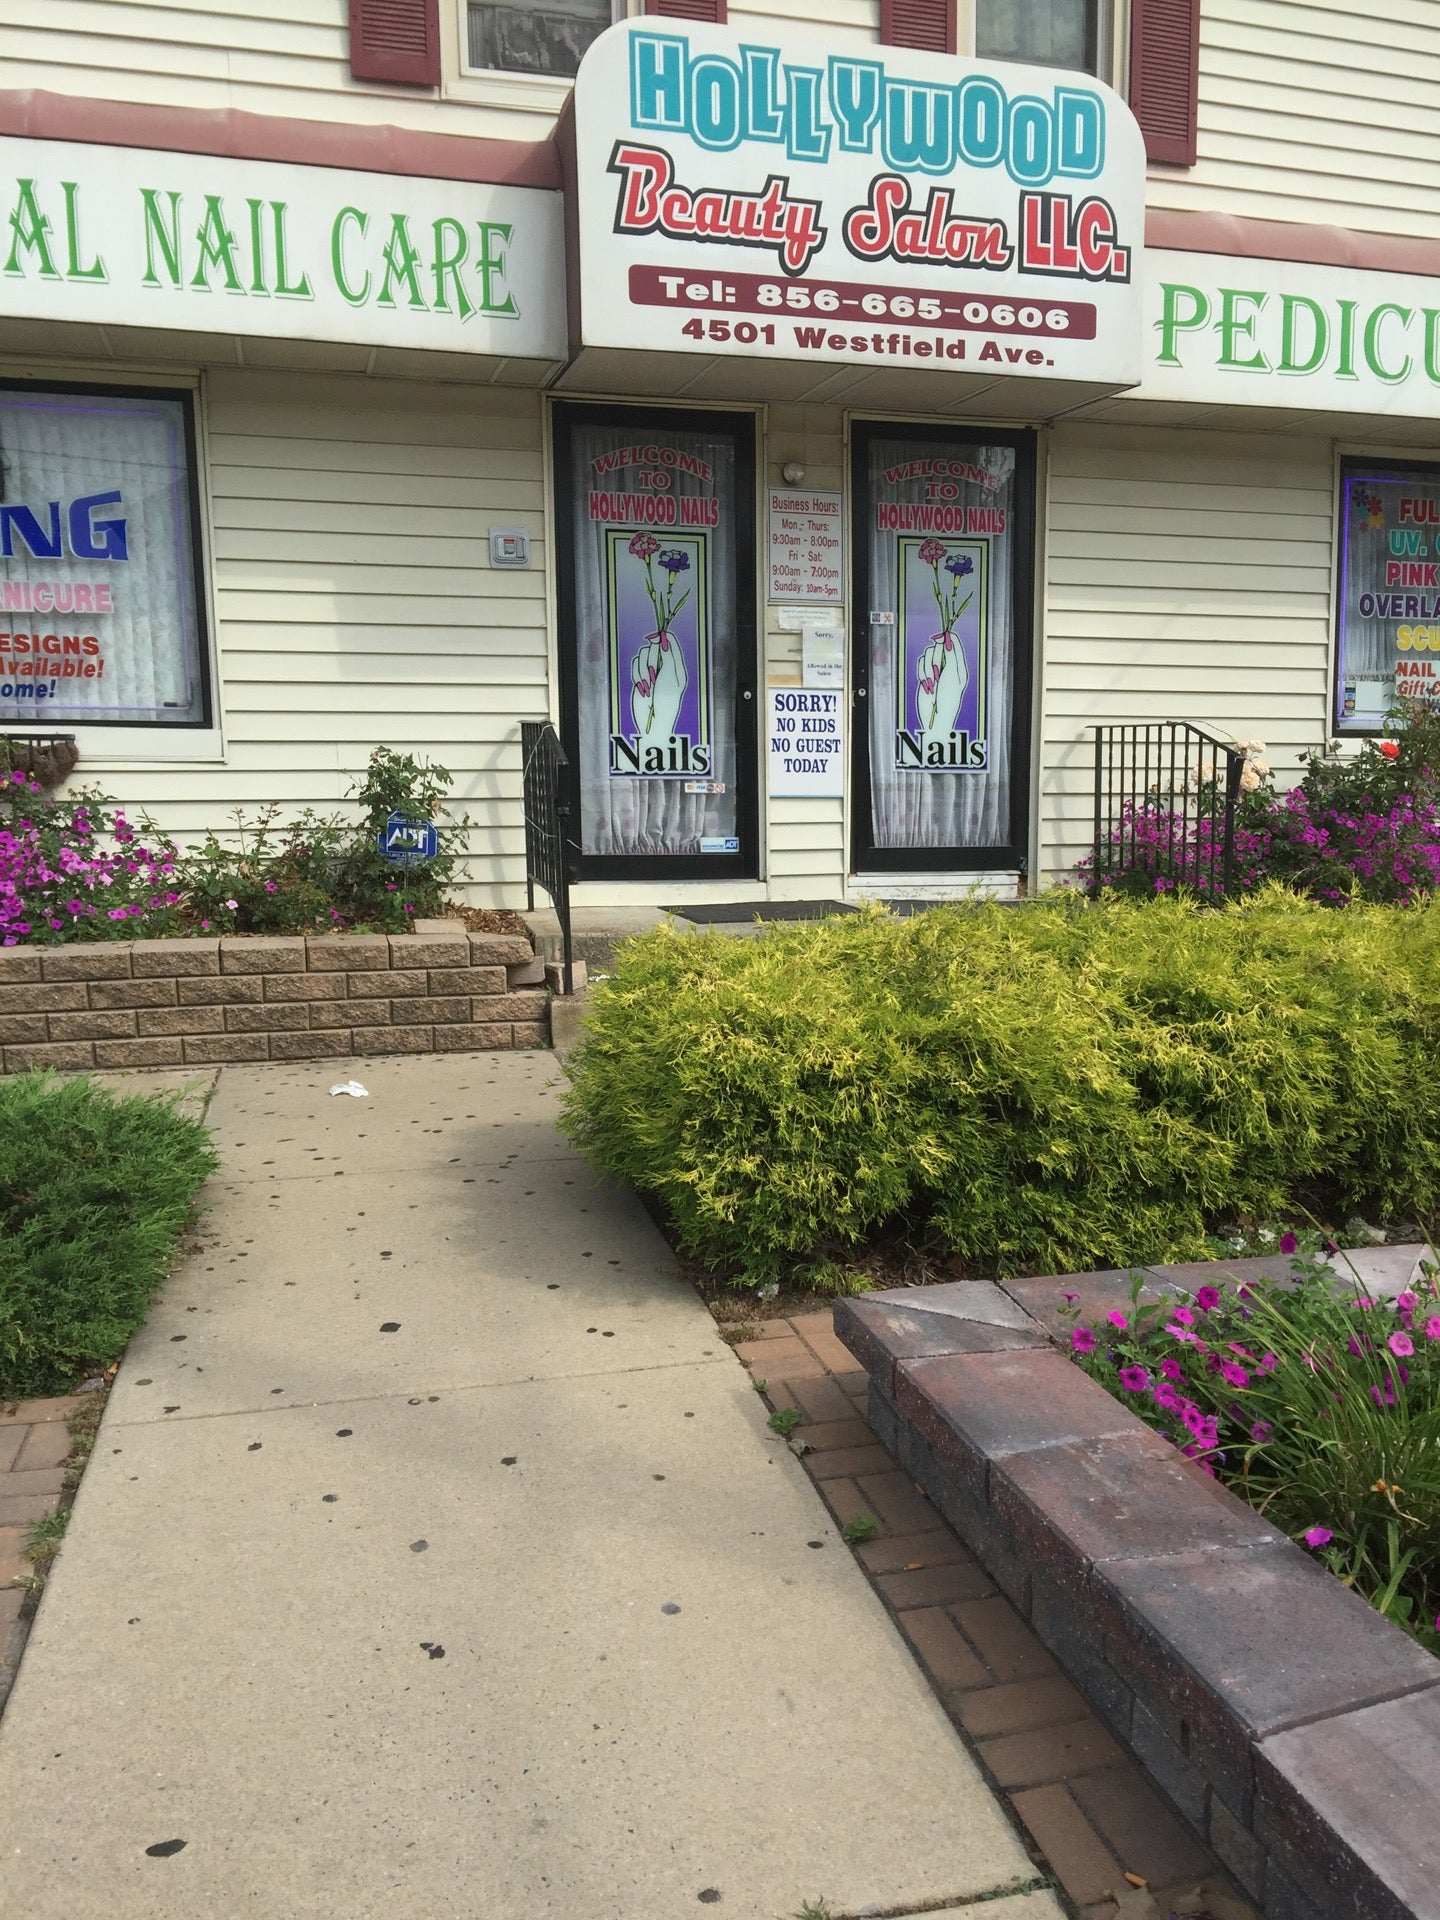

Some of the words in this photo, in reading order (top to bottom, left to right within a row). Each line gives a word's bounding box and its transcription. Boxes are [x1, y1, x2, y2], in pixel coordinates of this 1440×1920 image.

[629, 30, 1106, 187] HOLLYWOOD
[606, 139, 827, 277] Beauty
[843, 172, 1014, 272] Salon
[1018, 190, 1131, 284] LLC.
[3, 178, 109, 284] AL
[139, 188, 314, 301] NAIL
[331, 206, 521, 324] CARE
[658, 275, 736, 304] Tel:
[756, 284, 1071, 331] 856-665-0606
[681, 317, 776, 347] 4501
[793, 326, 966, 361] Westfield
[978, 340, 1056, 367] Ave.
[591, 445, 714, 484] WELCOME
[884, 458, 1000, 493] WELCOME
[640, 471, 671, 489] TO
[926, 482, 959, 500] TO
[588, 491, 677, 524] HOLLYWOOD
[680, 495, 719, 528] NAILS
[772, 496, 809, 511] Business
[812, 498, 839, 514] Hours:
[0, 490, 129, 561] NG
[782, 518, 798, 530] Mon
[807, 520, 830, 532] Thurs:
[878, 503, 964, 533] HOLLYWOOD
[967, 506, 1006, 536] NAILS
[772, 534, 801, 546] 9:30am
[810, 536, 839, 549] 8:00pm
[1390, 528, 1427, 556] UV.
[788, 550, 798, 561] Fri
[772, 565, 801, 577] 9:00am
[810, 566, 839, 580] 7:00pm
[1386, 561, 1440, 588] PINK
[0, 581, 114, 613] NICURE
[774, 580, 804, 594] Sunday:
[1397, 662, 1436, 677] NAIL
[0, 679, 56, 698] ome!
[1397, 680, 1425, 696] Gift
[775, 693, 837, 713] SORRY!
[776, 717, 796, 733] NO
[801, 718, 836, 734] KIDS
[610, 736, 708, 772] Nails
[771, 738, 791, 753] NO
[796, 738, 841, 754] GUEST
[898, 731, 985, 767] Nails
[783, 758, 829, 773] TODAY
